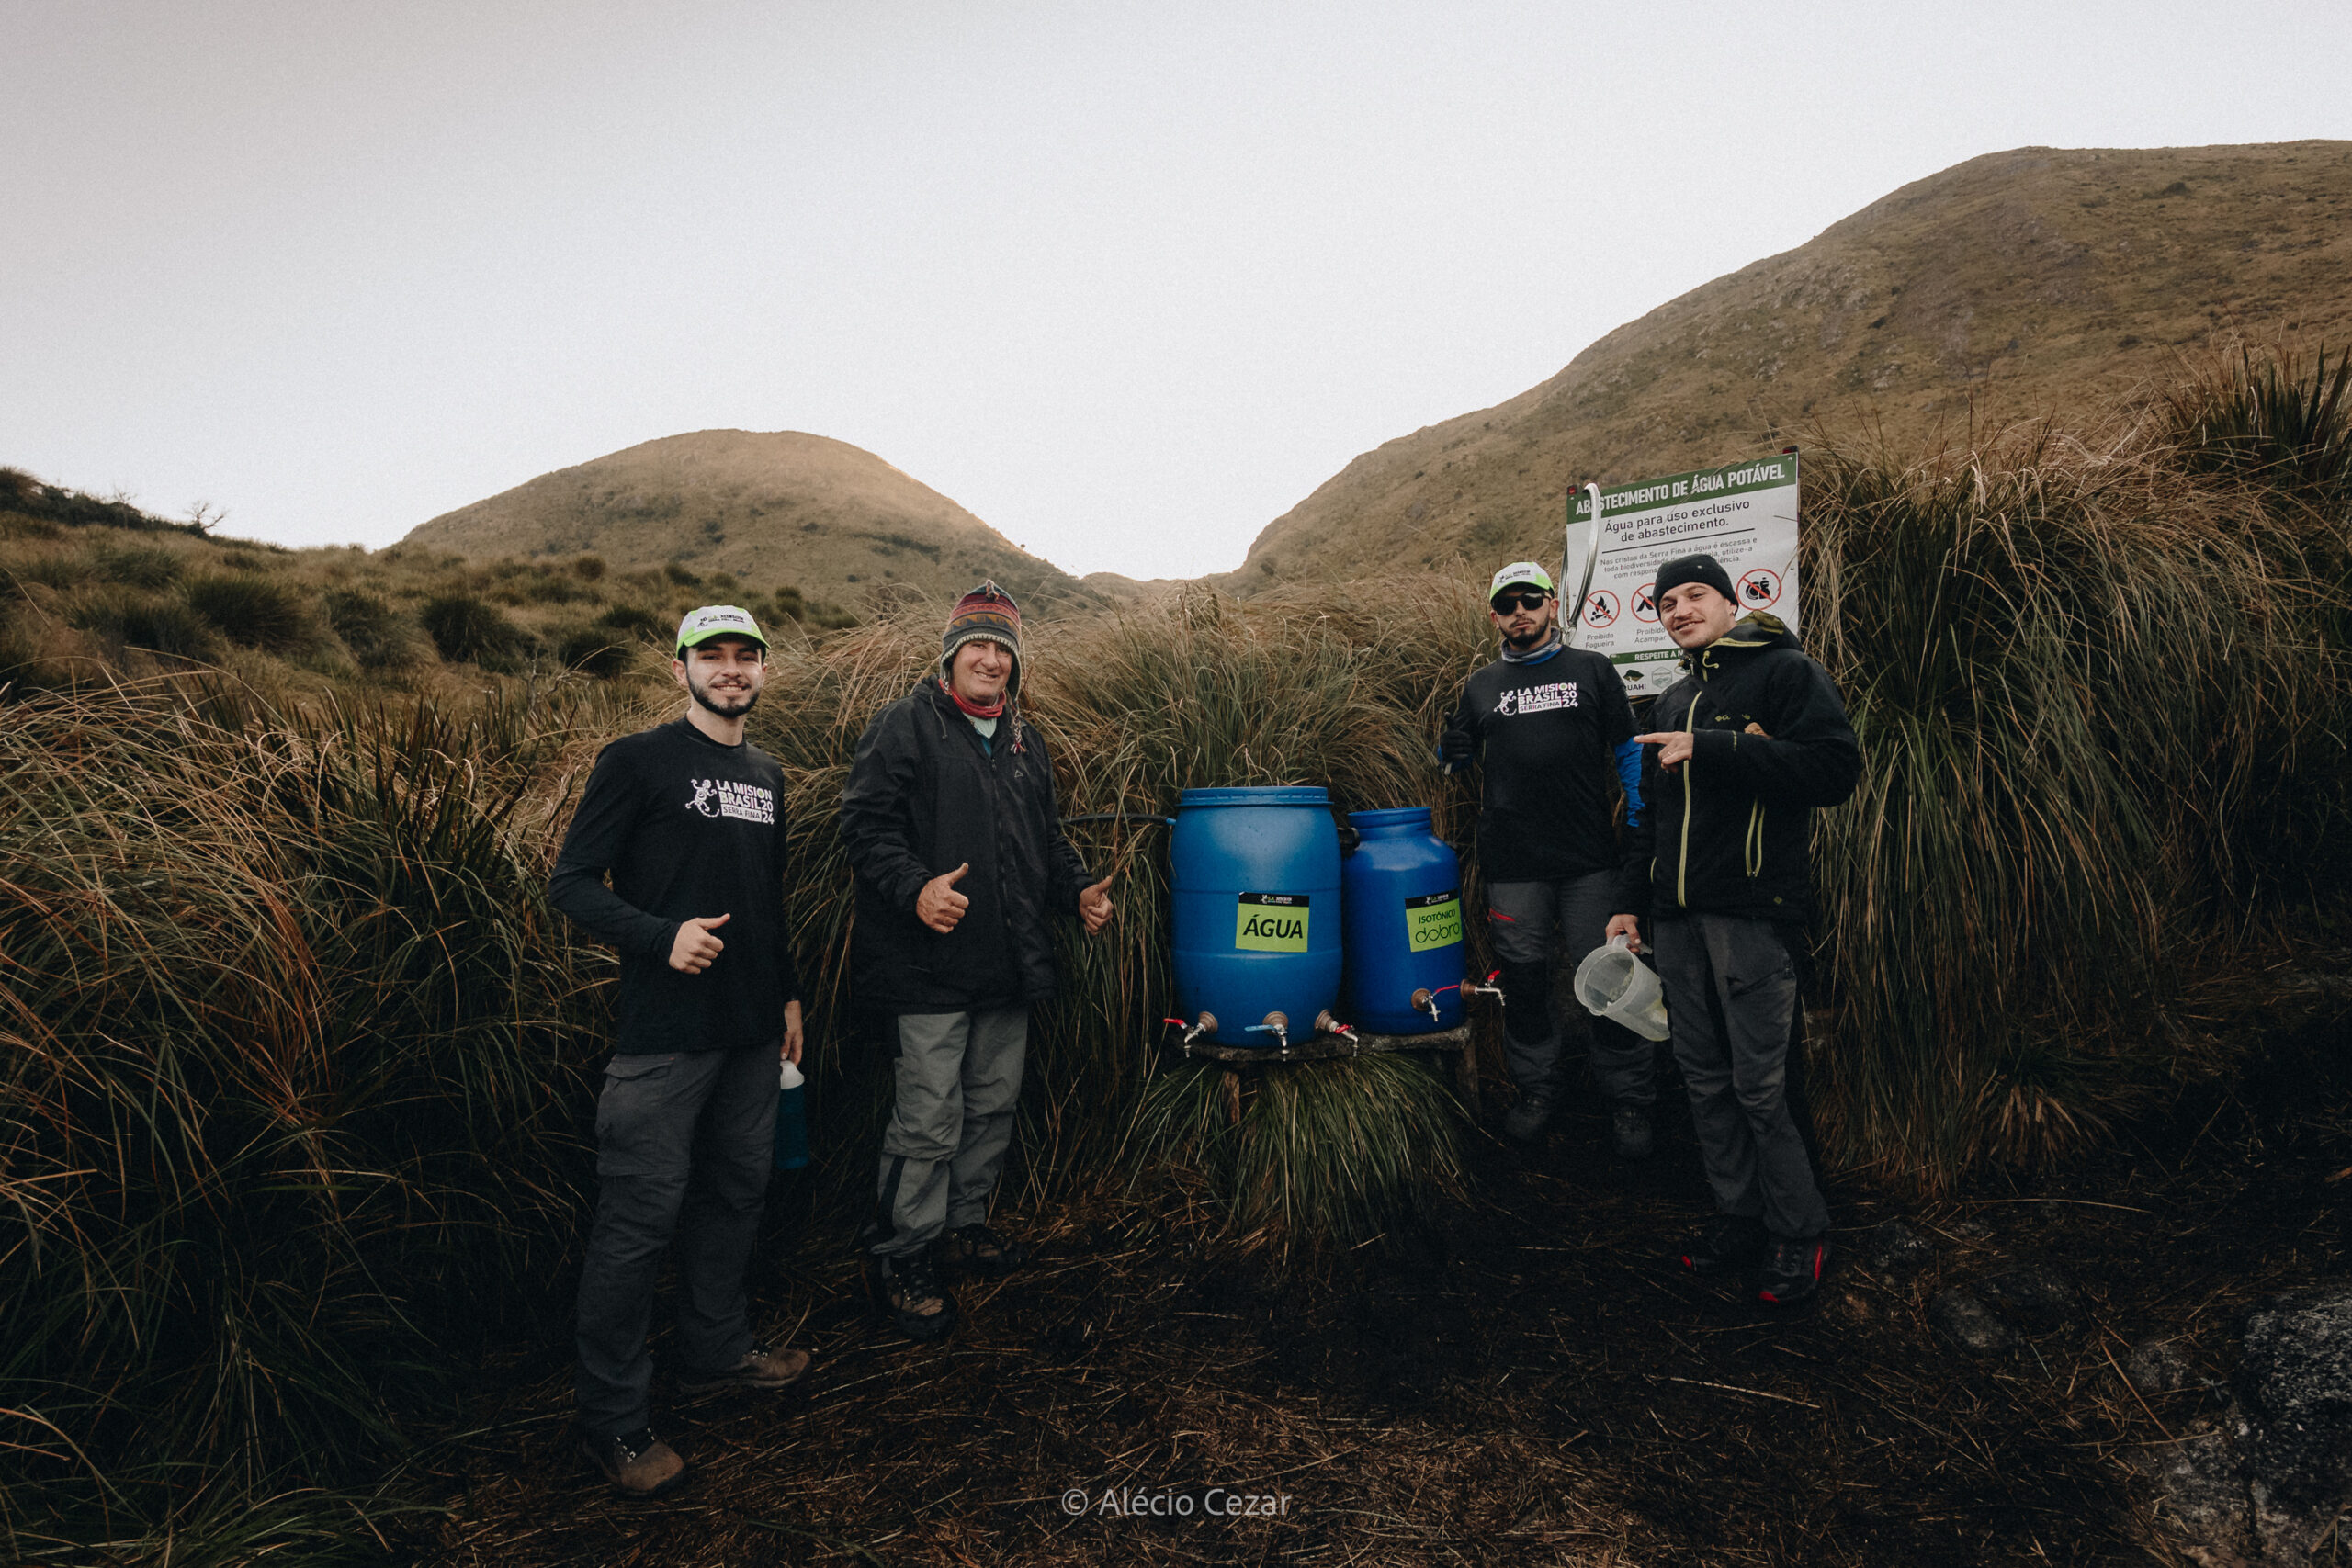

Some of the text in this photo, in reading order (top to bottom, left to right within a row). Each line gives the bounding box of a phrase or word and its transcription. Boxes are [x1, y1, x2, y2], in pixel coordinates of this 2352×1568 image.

[1576, 463, 1785, 515] ABSTECIMENTO DE ÁGUA POTÁVEL
[1605, 501, 1750, 534] Água para uso exclusivo
[1621, 517, 1729, 542] de abastecimento.
[1615, 555, 1638, 564] cristas
[1649, 551, 1669, 559] Serra
[1694, 544, 1712, 553] água
[1720, 538, 1751, 548] escassa
[1604, 565, 1618, 573] toda
[1613, 571, 1628, 580] com
[1630, 567, 1657, 578] respons
[1636, 627, 1666, 636] Proibido
[1634, 634, 1667, 644] Acampar
[1634, 650, 1669, 661] RESPEITE
[1670, 649, 1676, 658] A
[1517, 682, 1577, 697] LA MISION
[1520, 703, 1543, 713] SERRA
[1562, 699, 1578, 708] 24
[715, 778, 773, 801] LA MISION
[723, 805, 761, 819] SERRA FINA
[762, 812, 775, 825] 24
[1242, 913, 1304, 939] ÁGUA
